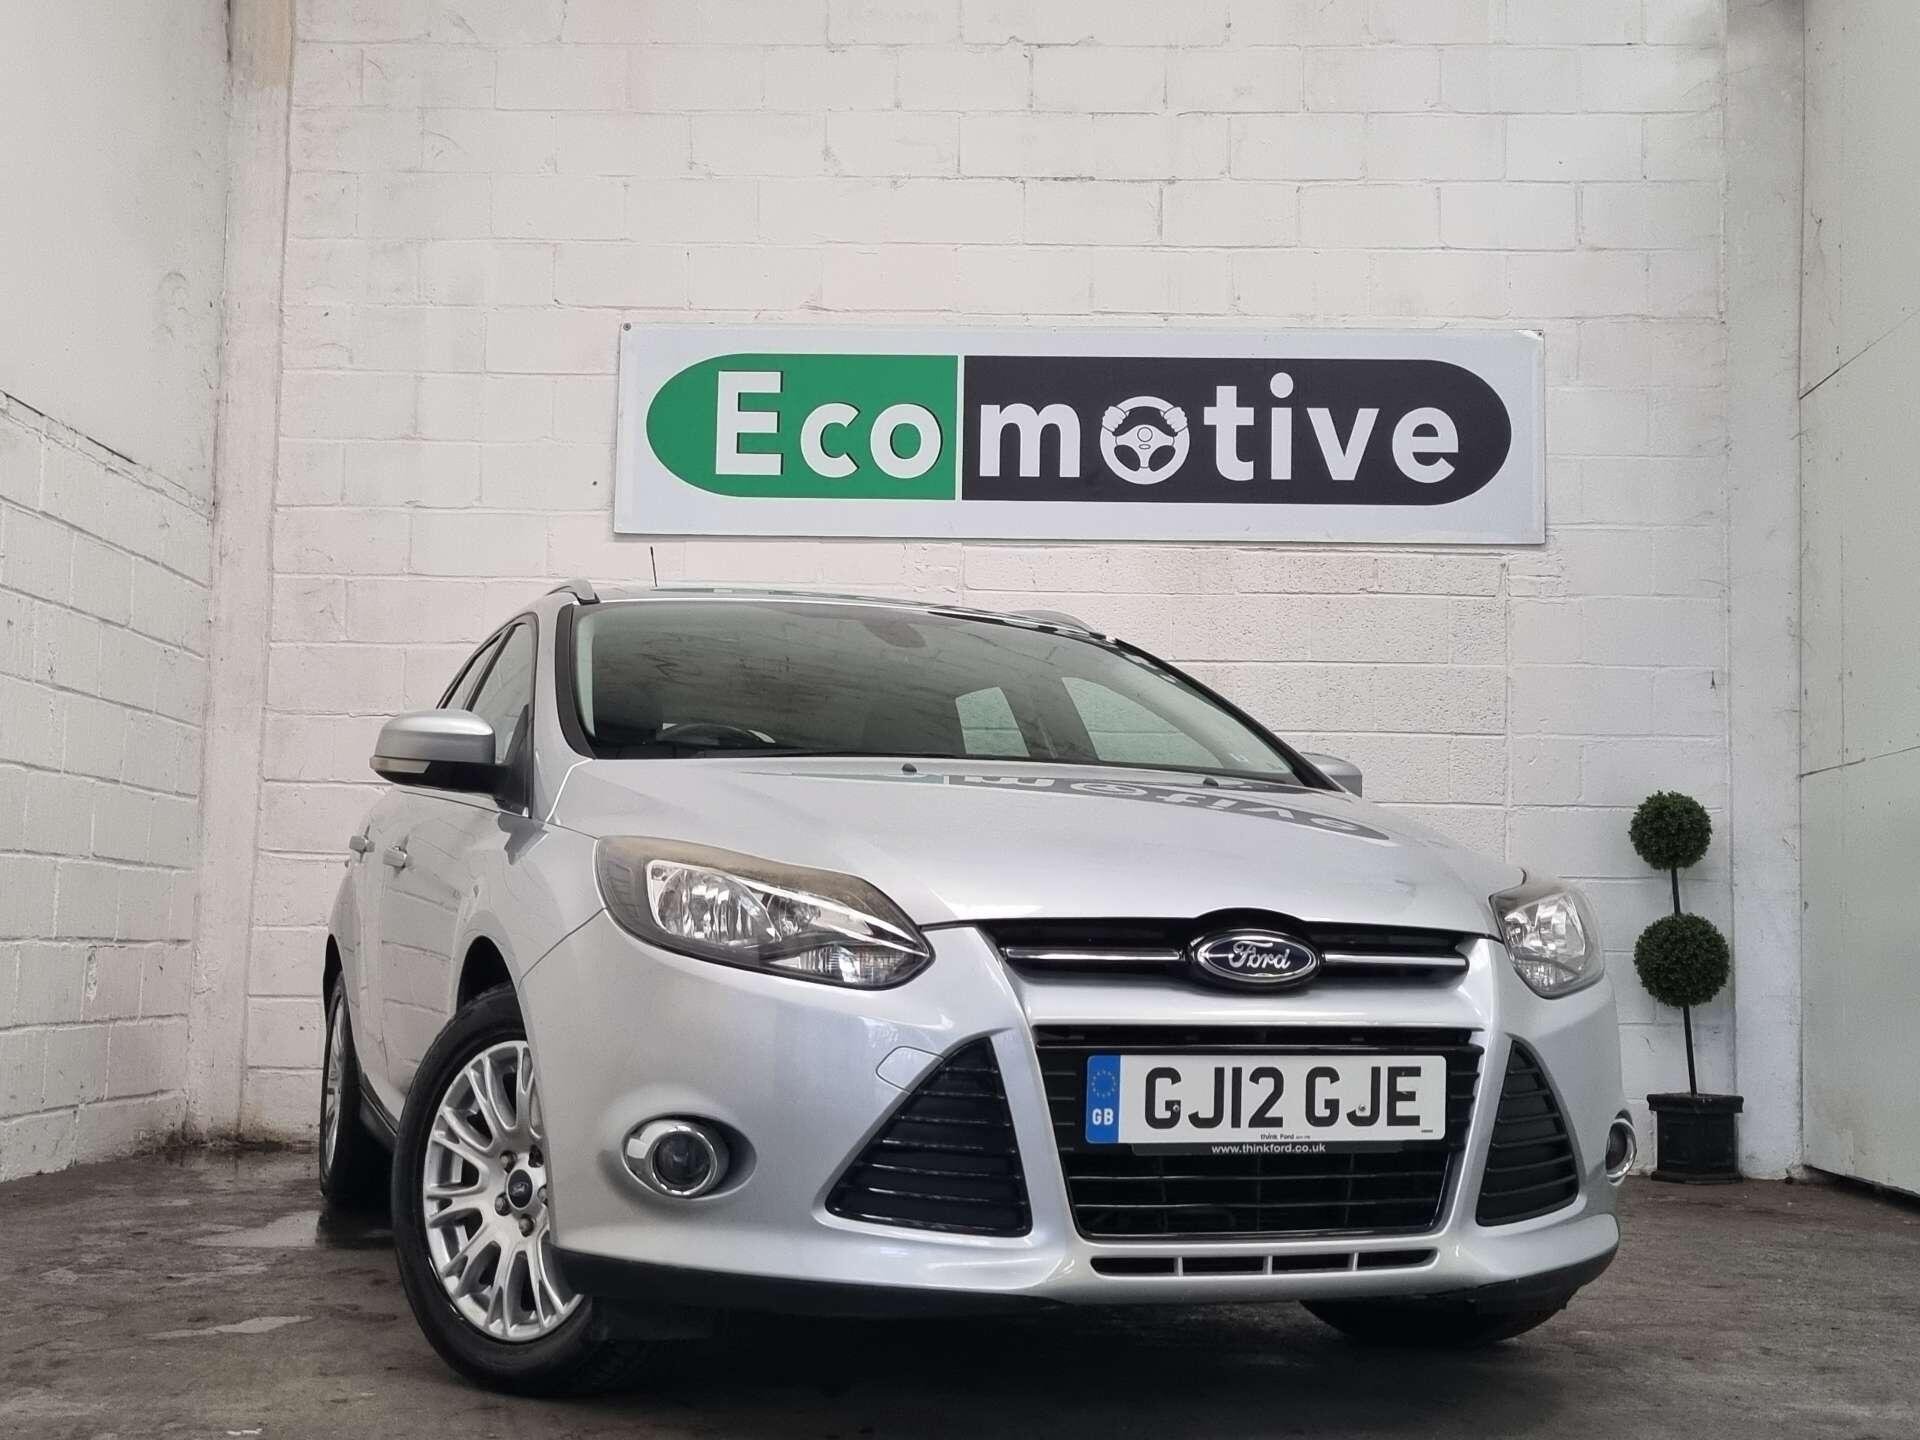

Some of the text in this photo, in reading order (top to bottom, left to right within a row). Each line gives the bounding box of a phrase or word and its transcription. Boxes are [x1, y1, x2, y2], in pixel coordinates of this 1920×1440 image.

[1228, 940, 1292, 969] Ford
[1144, 1066, 1422, 1129] GJ12 GJE
[1092, 1108, 1114, 1126] GB
[1211, 1142, 1326, 1155] www.thinkford.co.uk
